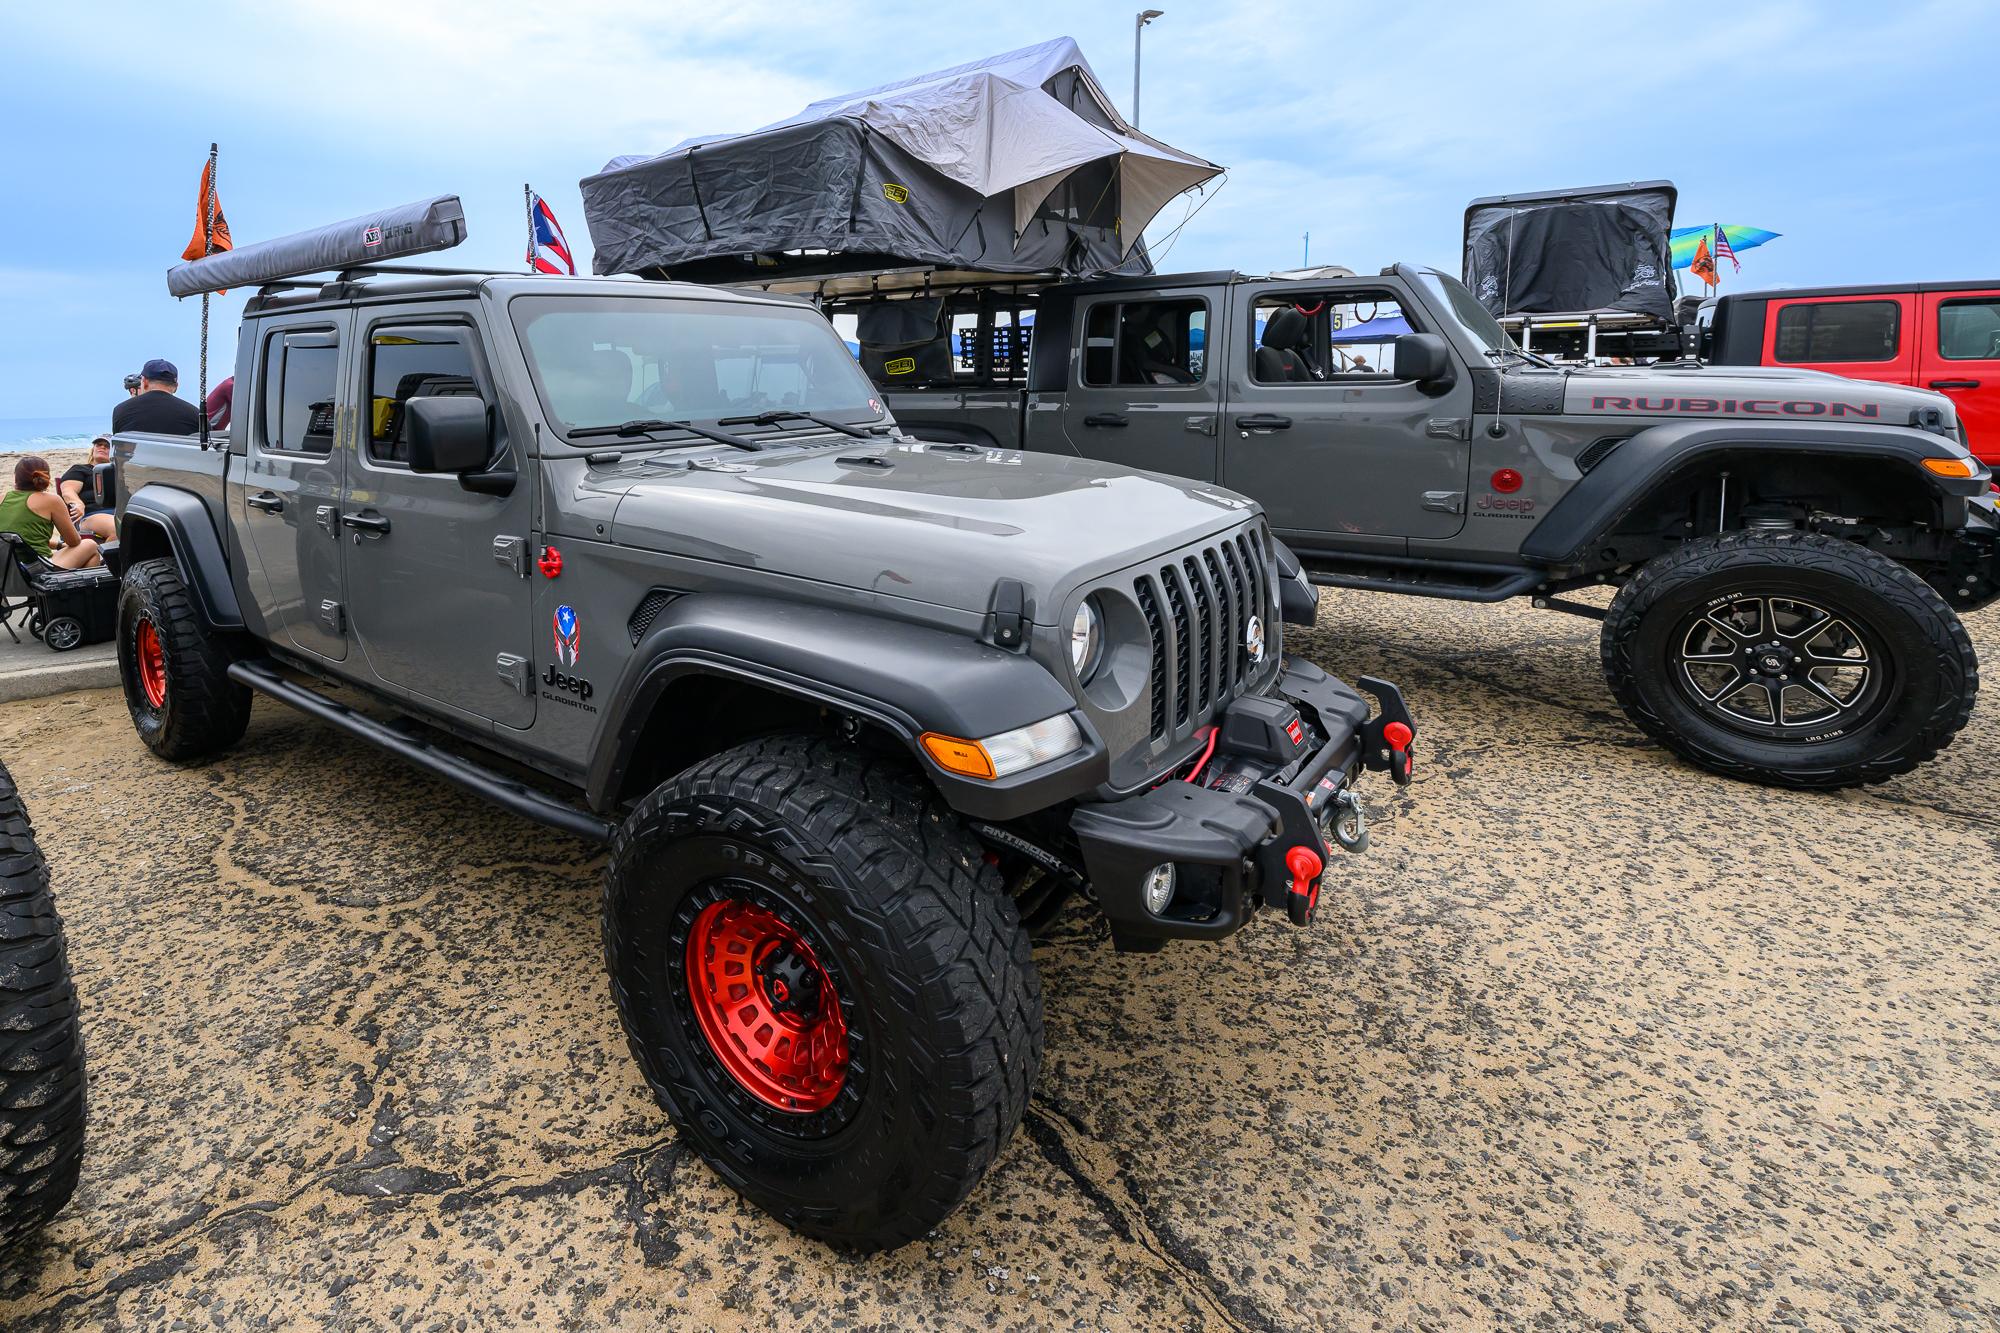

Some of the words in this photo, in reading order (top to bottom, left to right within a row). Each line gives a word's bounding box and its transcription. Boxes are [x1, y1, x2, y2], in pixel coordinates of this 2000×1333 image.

[1333, 314, 1342, 330] 5
[1591, 396, 1880, 417] RUBICON
[1476, 494, 1535, 513] Jeep
[1472, 511, 1535, 520] GLADIATOR
[542, 663, 594, 701] Jeep
[542, 691, 598, 714] GLADIATOR
[982, 825, 1062, 868] ANTIROCK
